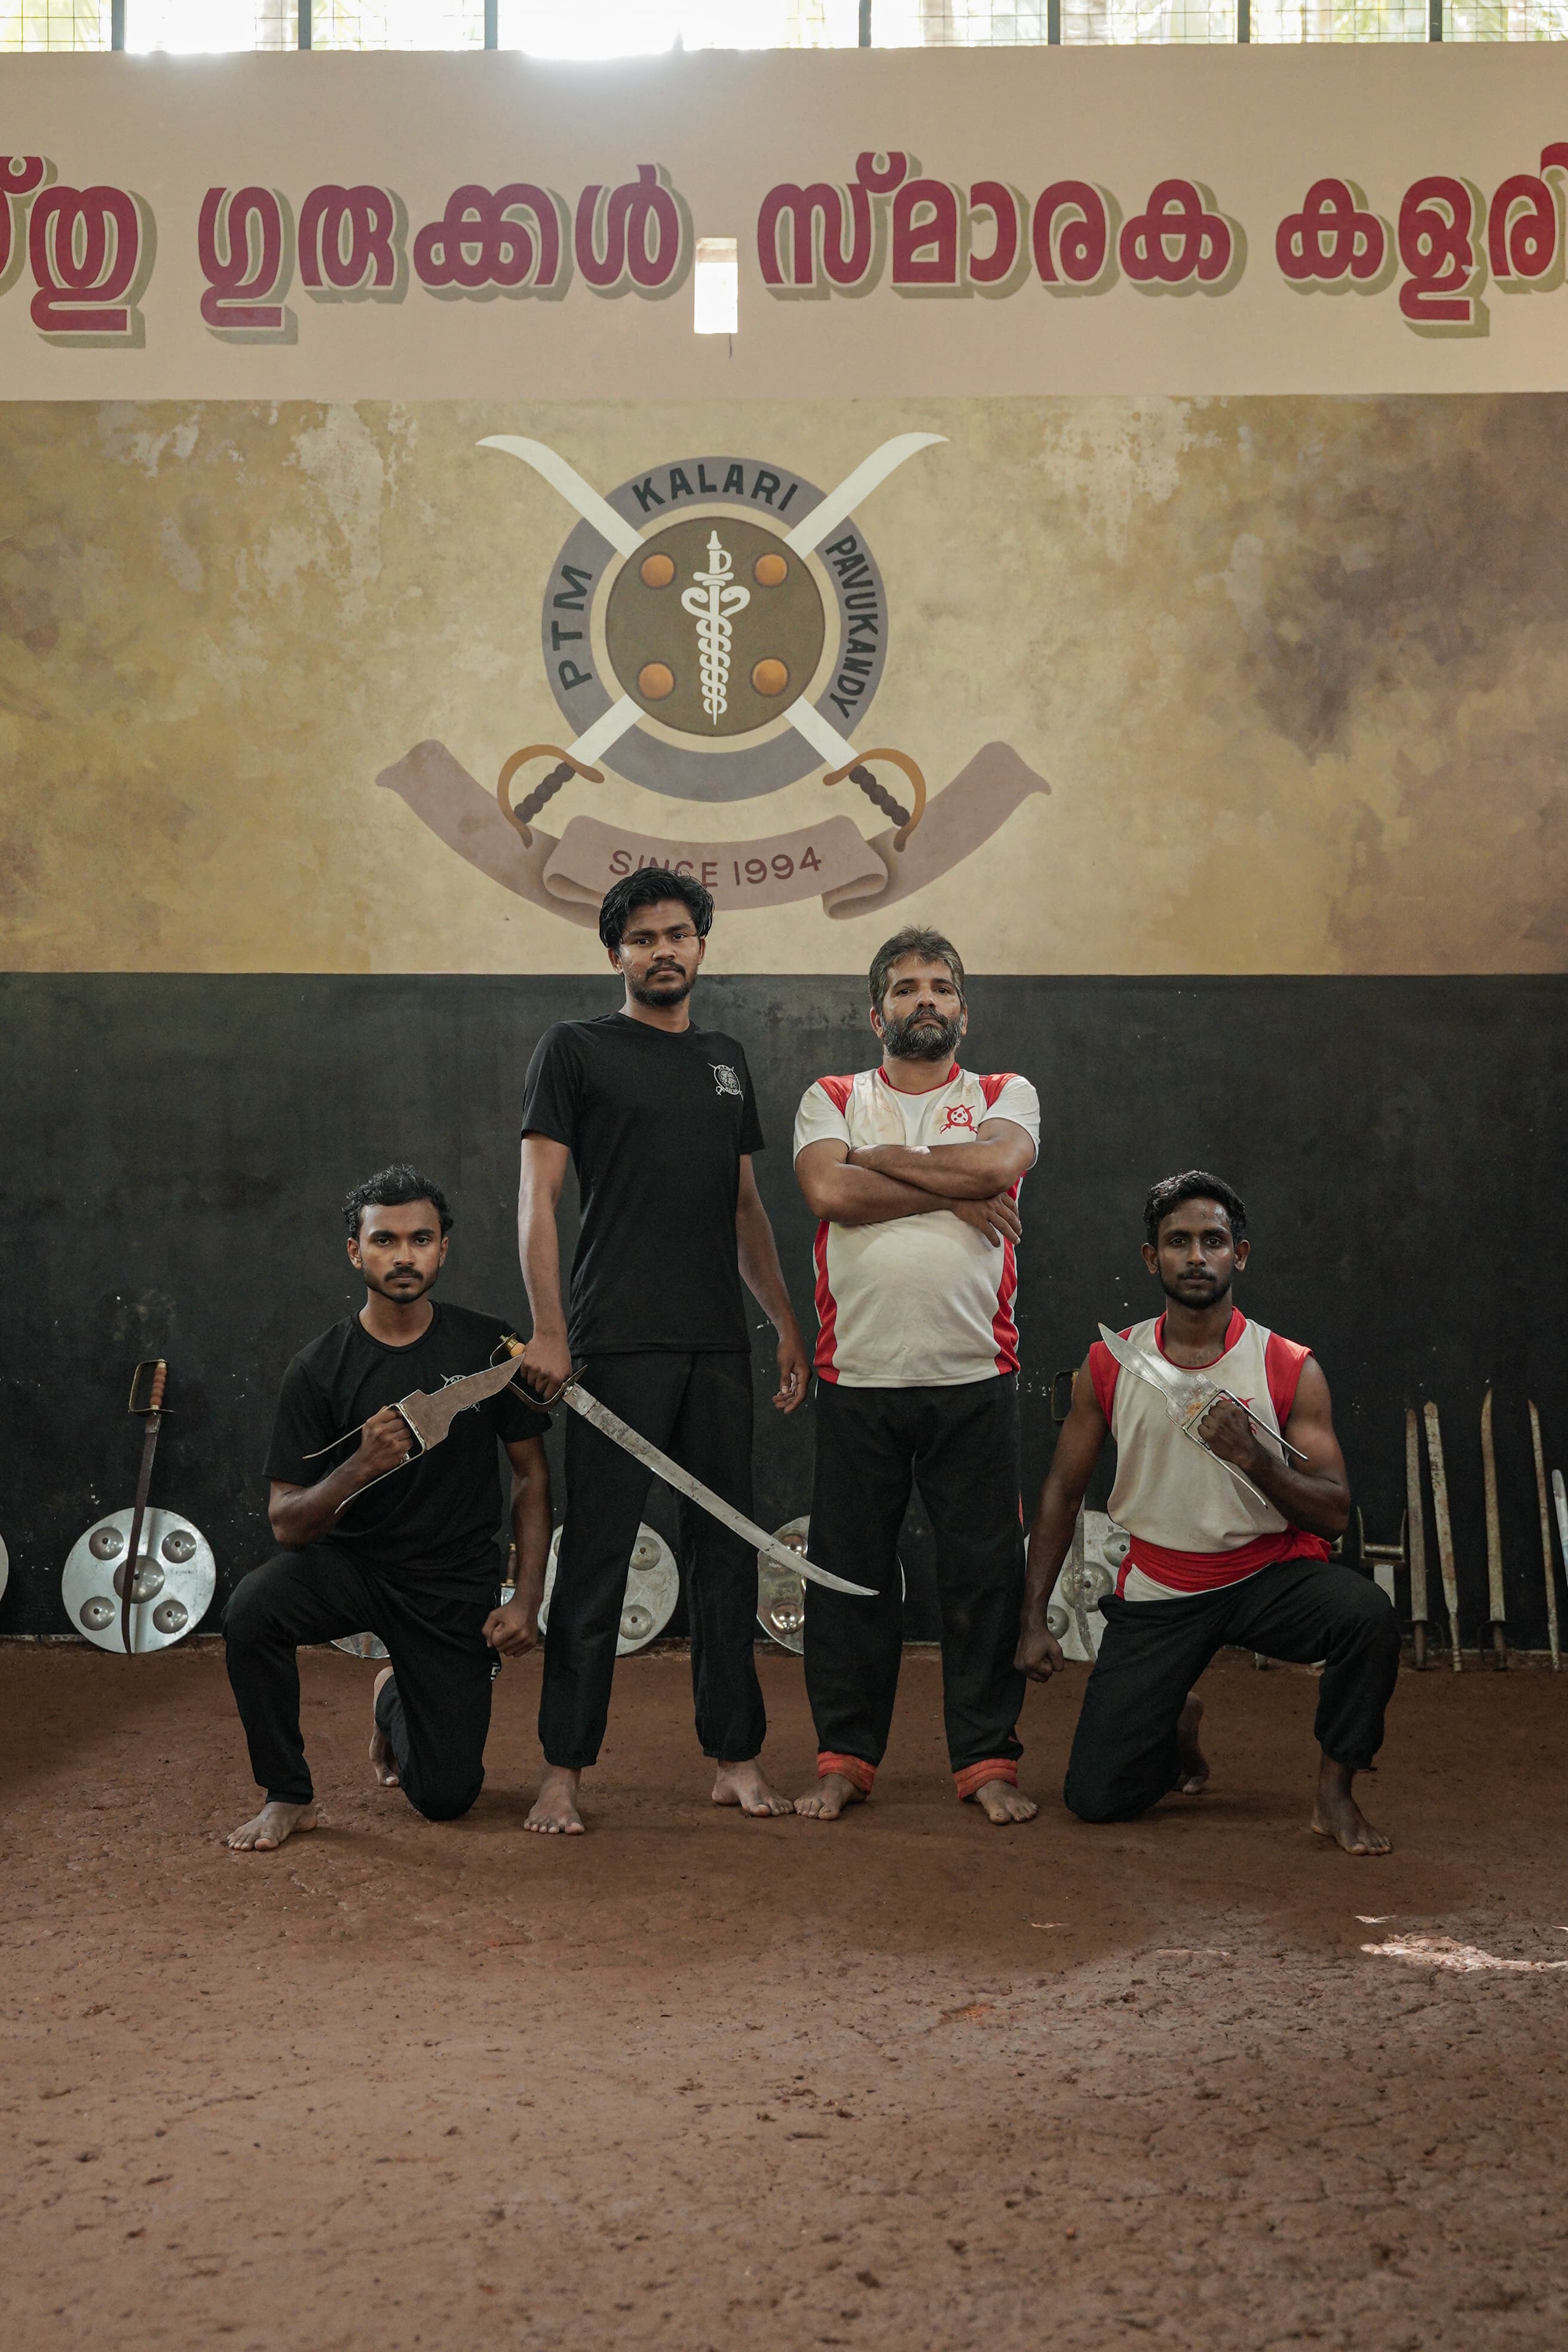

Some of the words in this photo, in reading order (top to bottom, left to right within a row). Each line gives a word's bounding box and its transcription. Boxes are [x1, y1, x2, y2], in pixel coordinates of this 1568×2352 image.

[197, 163, 681, 329] ഗുരുക്കൾ
[756, 151, 1233, 286] സ്മാരക
[551, 564, 593, 691] PTM
[632, 463, 799, 513] KALARI
[825, 534, 879, 719] PAVUKANDY
[733, 846, 822, 886] 1994
